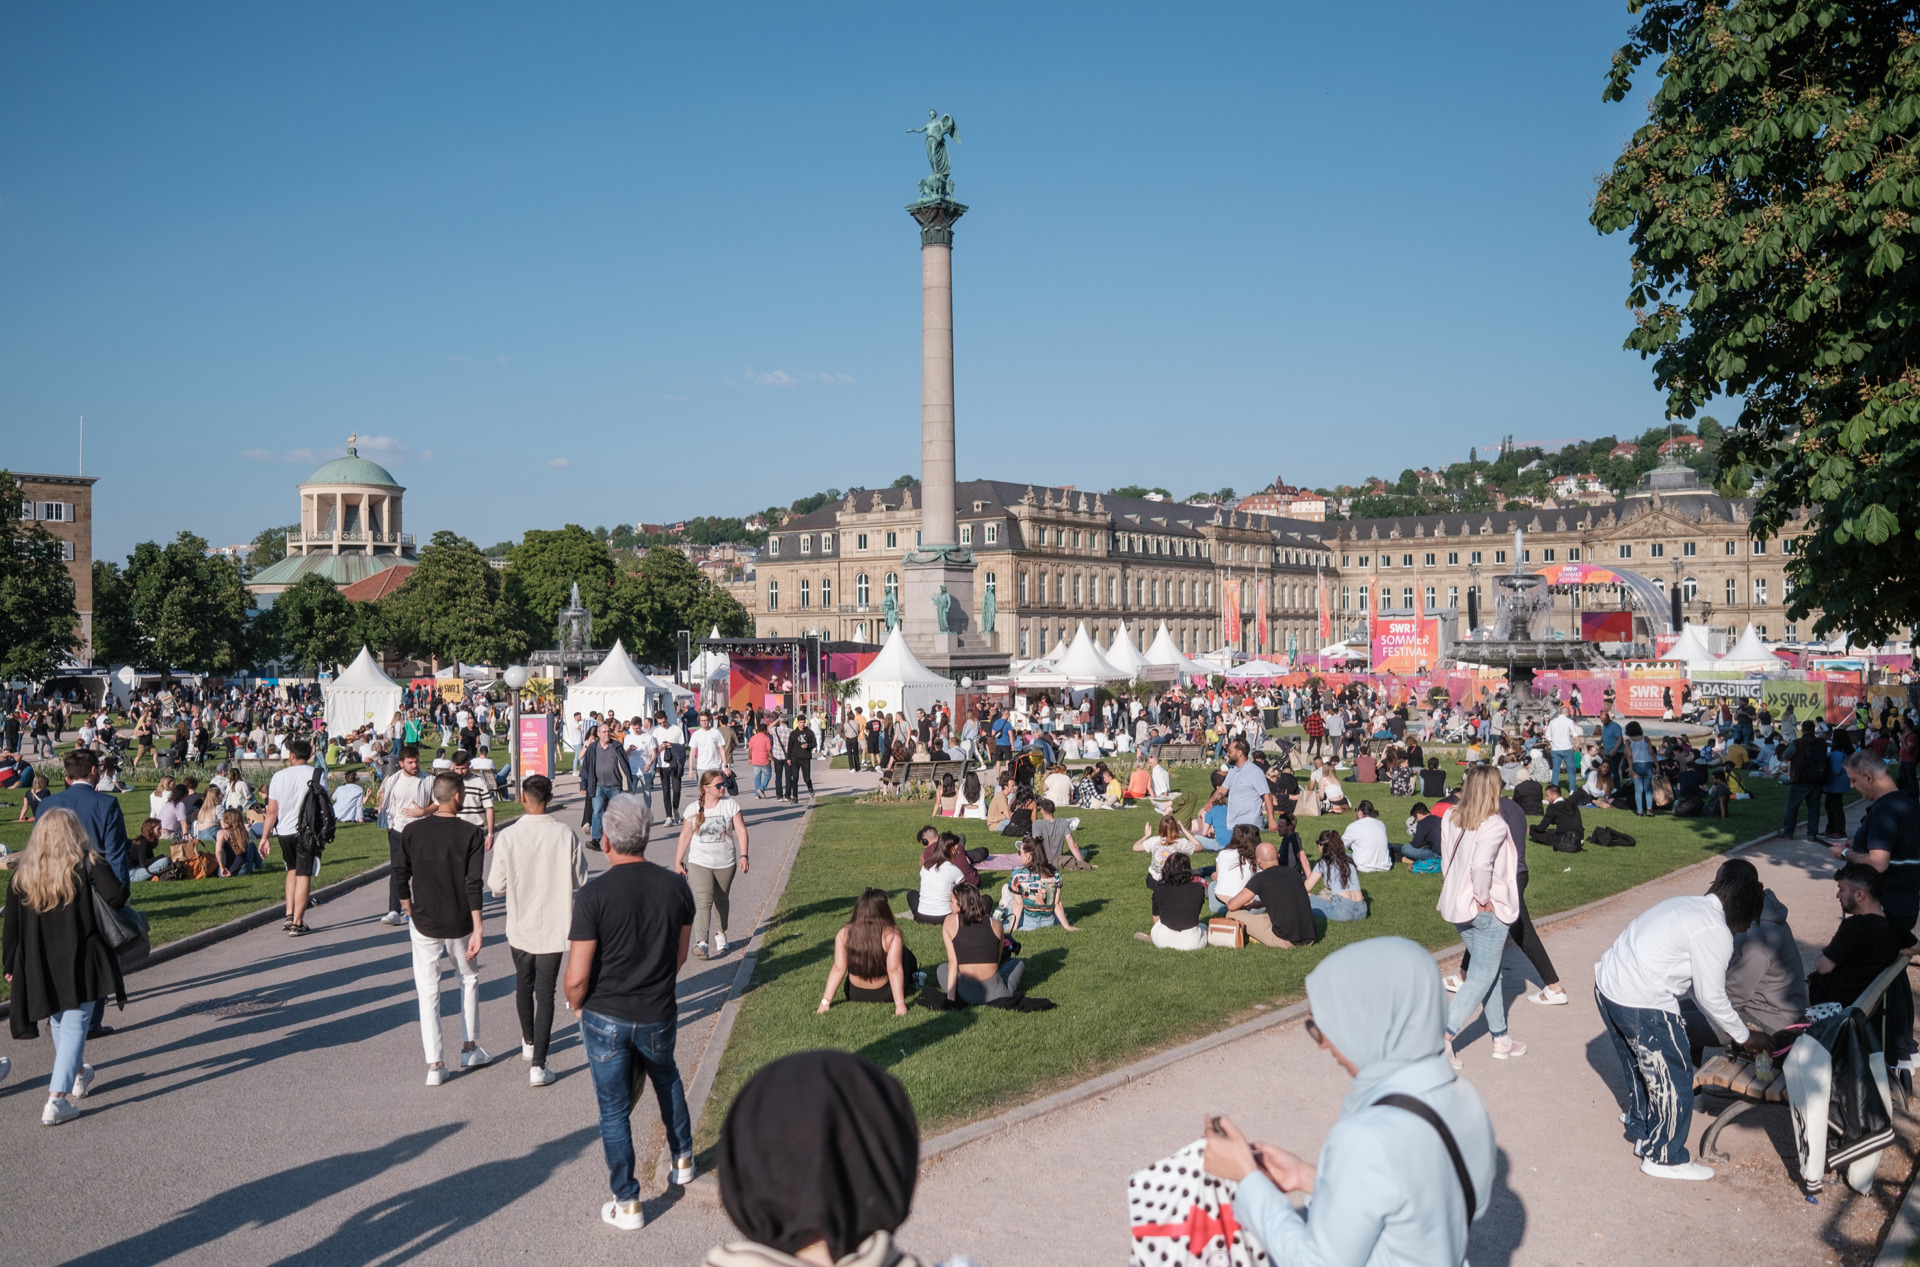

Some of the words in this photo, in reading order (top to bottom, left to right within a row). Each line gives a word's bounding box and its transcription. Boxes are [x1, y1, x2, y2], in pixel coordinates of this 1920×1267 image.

[1390, 623, 1411, 633] SWR
[1381, 635, 1430, 645] SOMMER
[1382, 647, 1429, 656] FESTIVAL
[1629, 685, 1659, 698] SWR
[1702, 683, 1761, 698] DASDING
[1780, 692, 1819, 709] SWR4
